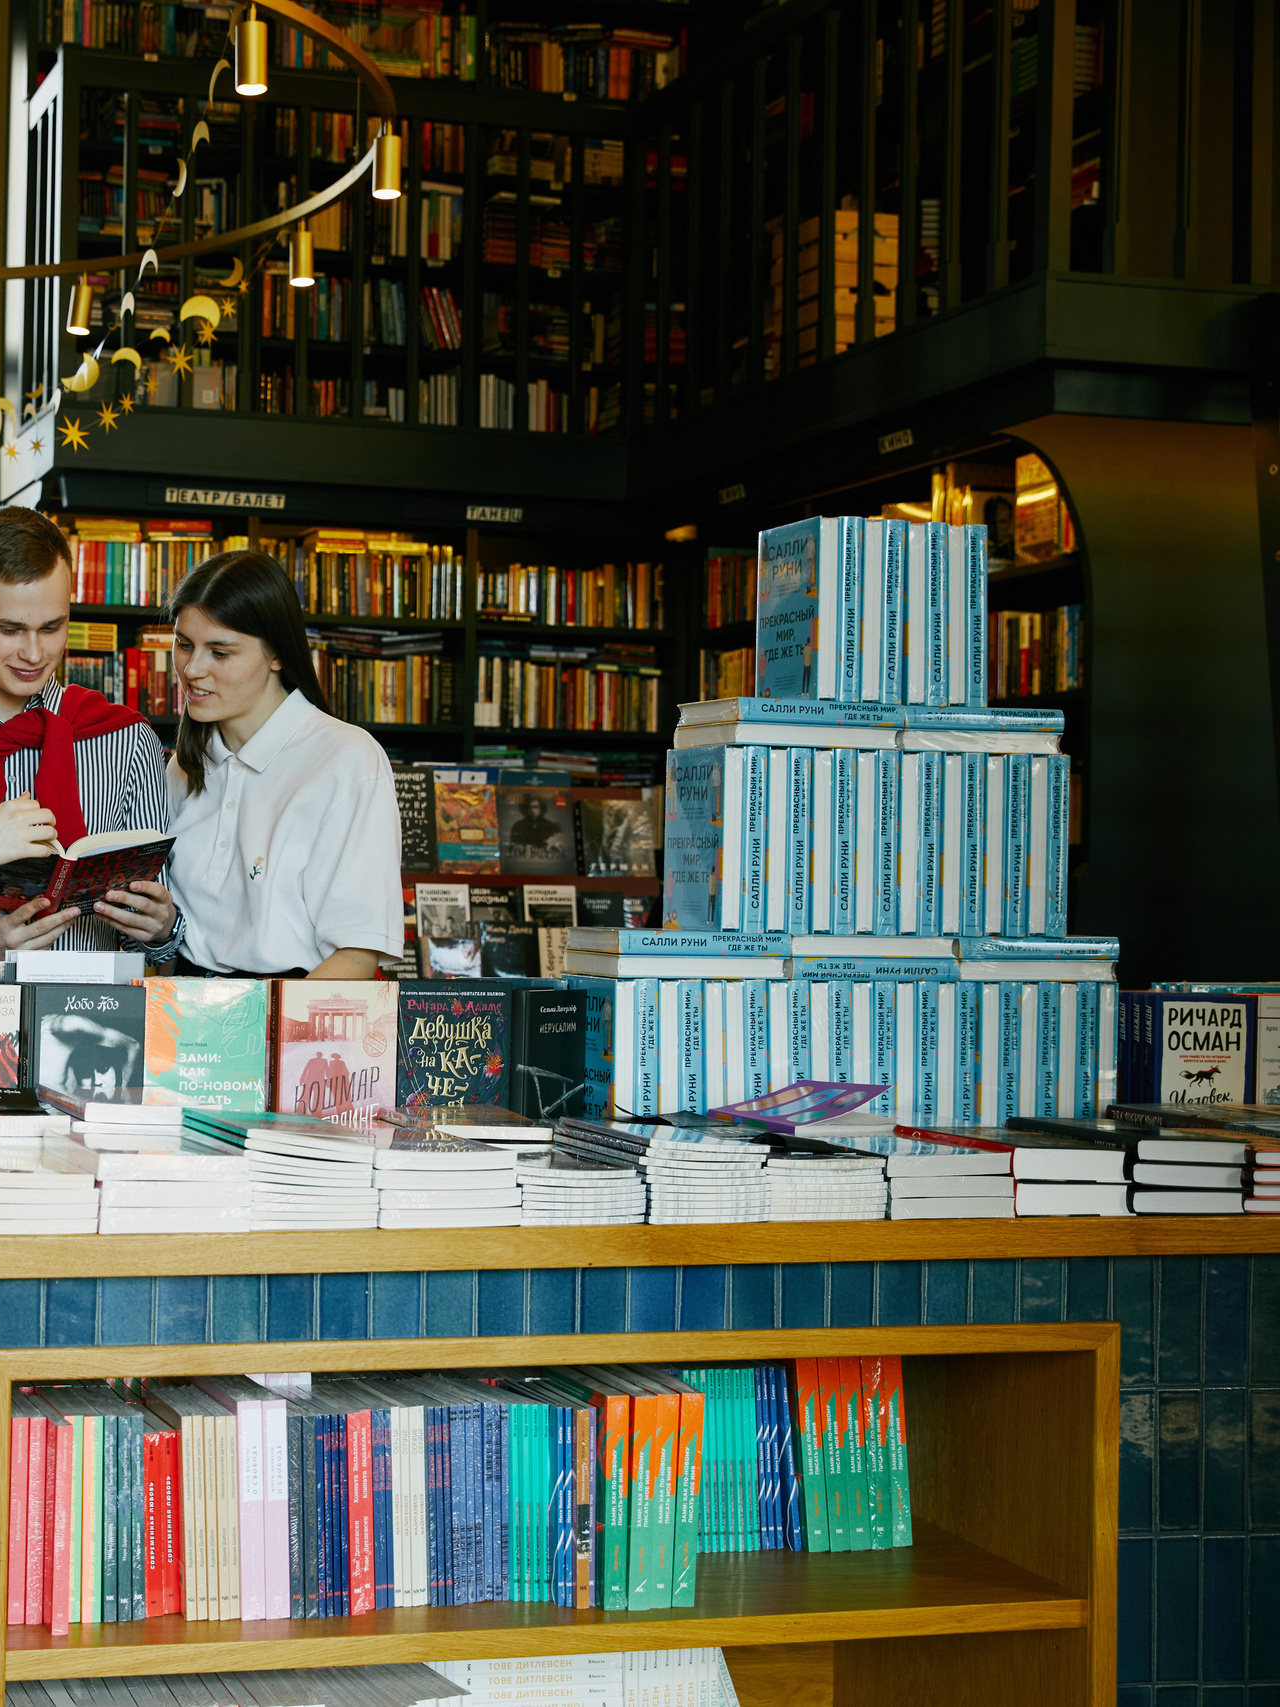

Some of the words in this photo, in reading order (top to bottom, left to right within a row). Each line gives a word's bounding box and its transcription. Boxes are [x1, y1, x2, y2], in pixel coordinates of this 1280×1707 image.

[879, 432, 911, 452] КИНО
[168, 489, 283, 507] ТЕАТР/БАЛЕТ
[468, 507, 521, 521] ТАНЕЦ
[768, 537, 809, 561] САЛЛИ
[931, 530, 939, 556] МИР,
[772, 559, 802, 581] РУНИ
[844, 551, 852, 602] ПРЕКРАСНЫЙ
[931, 557, 939, 607] ПРЕКРАСНЫЙ
[759, 605, 815, 630] ПРЕКРАСНЫЙ
[847, 608, 856, 638] РУНИ
[776, 629, 796, 643] МИР,
[934, 613, 942, 643] РУНИ
[765, 648, 779, 664] ГДЕ
[780, 646, 794, 658] ЖЕ
[846, 639, 854, 678] САЛЛИ
[934, 644, 942, 683] САЛЛИ
[761, 704, 797, 714] САЛЛИ
[799, 705, 825, 716] РУНИ
[829, 703, 879, 713] ПРЕКРАСНЫЙ
[881, 706, 898, 715] МИР,
[844, 713, 857, 721] ГДЕ
[872, 714, 883, 722] ТЫ
[676, 765, 713, 781] САЛЛИ
[680, 786, 708, 801] РУНИ
[667, 833, 719, 849] ПРЕКРАСНЫЙ
[78, 849, 138, 869] КТО
[683, 854, 701, 867] МИР,
[752, 838, 761, 867] РУНИ
[883, 842, 892, 871] РУНИ
[673, 871, 687, 884] ГДЕ
[687, 872, 699, 883] ЖЕ
[752, 870, 760, 909] САЛЛИ
[883, 874, 891, 912] САЛЛИ
[642, 937, 678, 947] САЛЛИ
[681, 938, 707, 948] РУНИ
[712, 934, 764, 943] ПРЕКРАСНЫЙ
[765, 936, 784, 944] МИР,
[728, 944, 741, 952] ГДЕ
[842, 962, 856, 970] ГДЕ
[876, 966, 902, 976] РУНИ
[904, 966, 938, 976] САЛЛИ
[802, 970, 818, 979] МИР,
[820, 970, 870, 979] ПРЕКРАСНЫЙ
[64, 995, 94, 1012] Кобо
[97, 995, 119, 1012] Абэ
[406, 999, 449, 1014] Ричард
[465, 1001, 502, 1016] Адамс
[540, 1005, 557, 1013] Сельма
[694, 1006, 699, 1016] ТЫ
[930, 1006, 936, 1017] ТЫ
[694, 1020, 700, 1033] ЖЕ
[930, 1020, 936, 1033] ЖЕ
[1168, 1008, 1242, 1029] РИЧАРД
[409, 1014, 493, 1054] Девушка
[539, 1022, 577, 1034] ИЕРУСАЛИМ
[1167, 1031, 1241, 1051] ОСМАН
[179, 1053, 221, 1063] ЗАМИ:
[179, 1067, 205, 1077] КАК
[179, 1081, 262, 1092] ПО-НОВОМУ
[294, 1066, 380, 1114] КОШМАР
[689, 1073, 697, 1102] РУНИ
[924, 1073, 932, 1101] РУНИ
[488, 1662, 513, 1671] ТОВЕ
[515, 1659, 572, 1670] ДИТЛЕВСЕН
[488, 1677, 513, 1685] ТОВЕ
[515, 1674, 572, 1685] ДИТЛЕВСЕН
